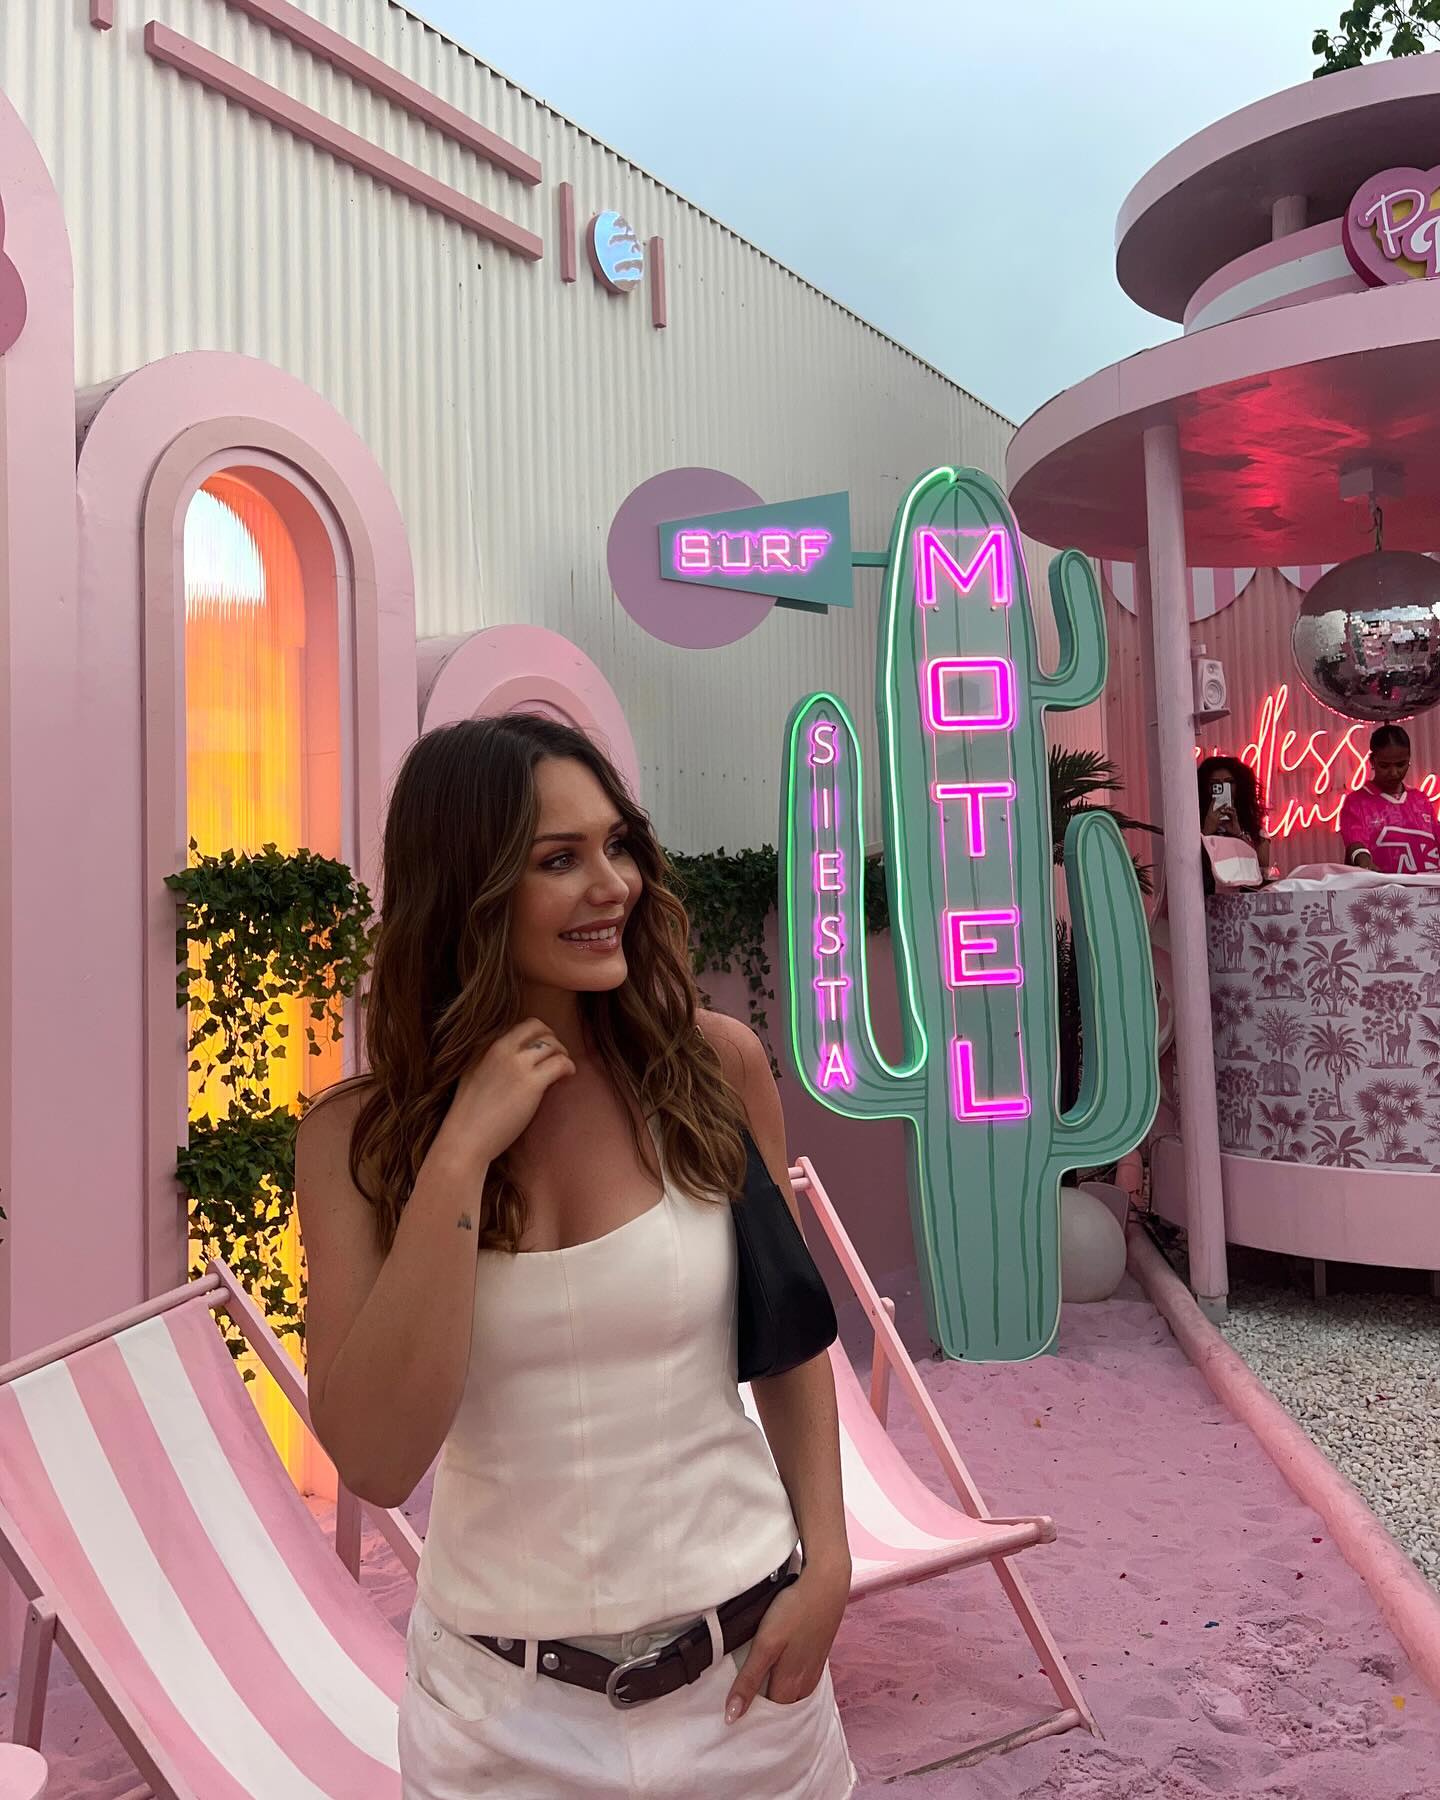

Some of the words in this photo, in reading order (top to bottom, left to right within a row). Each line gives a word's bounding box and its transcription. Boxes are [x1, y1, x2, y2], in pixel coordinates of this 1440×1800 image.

[679, 533, 831, 569] SURF
[810, 725, 851, 1088] SIESTA
[918, 529, 1029, 1118] MOTEL
